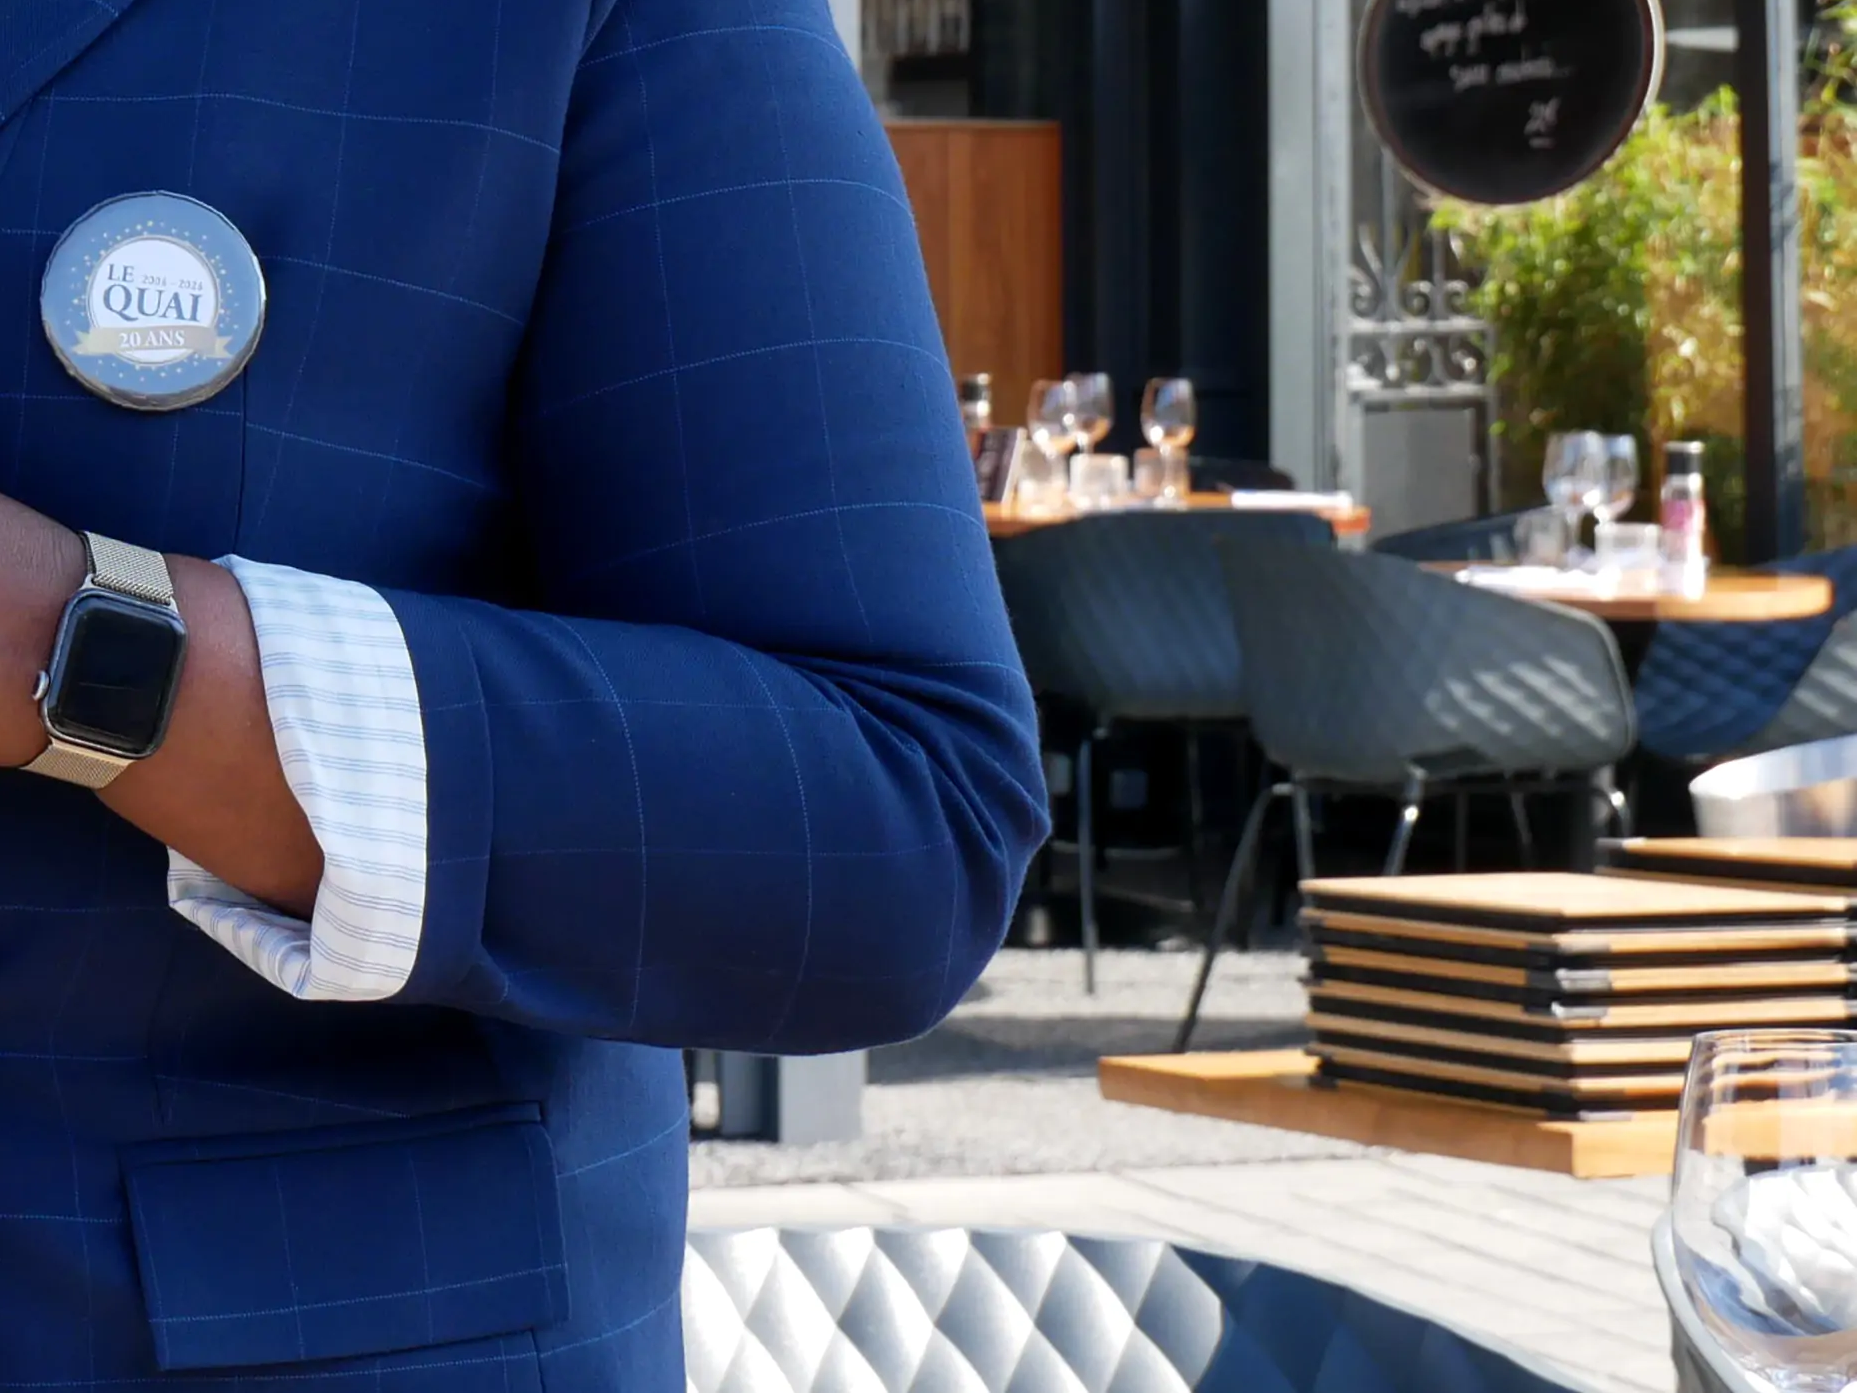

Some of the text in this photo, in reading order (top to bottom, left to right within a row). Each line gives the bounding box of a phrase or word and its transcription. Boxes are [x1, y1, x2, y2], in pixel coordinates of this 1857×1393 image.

[107, 263, 135, 283] LE
[103, 284, 201, 322] QUAI
[119, 330, 185, 347] 20 ANS
